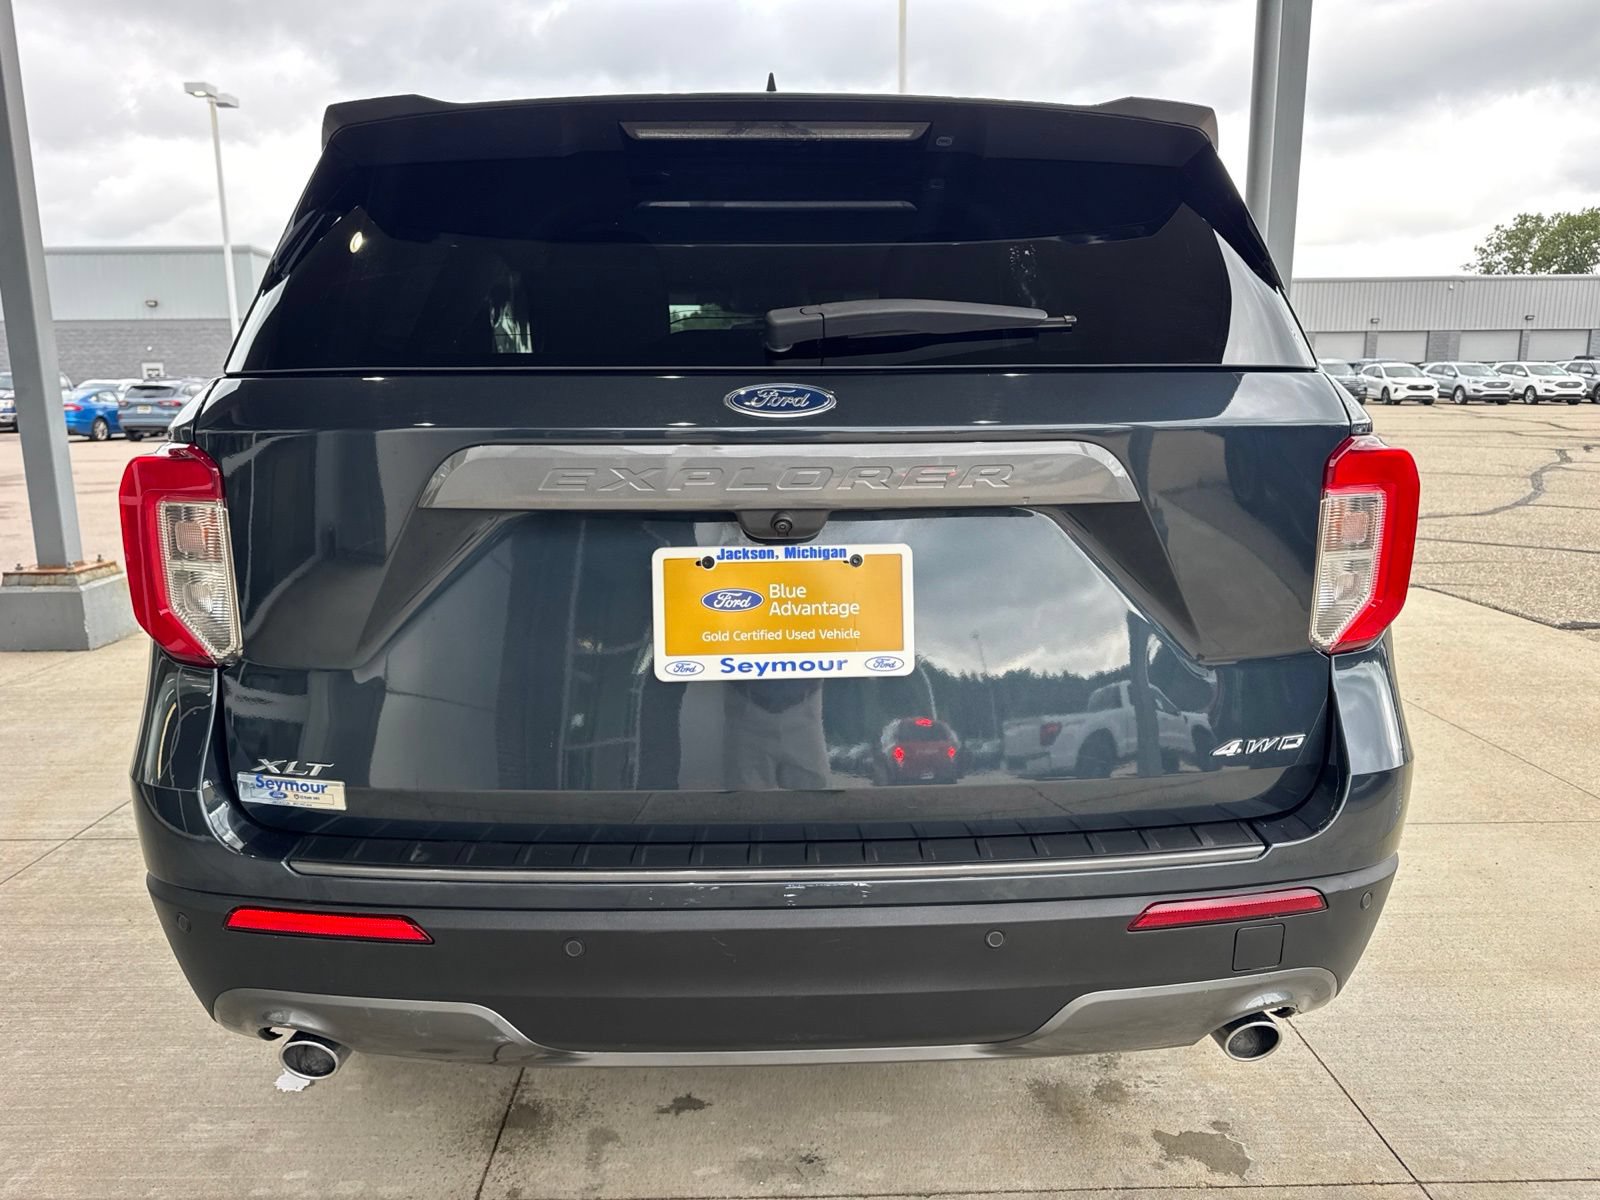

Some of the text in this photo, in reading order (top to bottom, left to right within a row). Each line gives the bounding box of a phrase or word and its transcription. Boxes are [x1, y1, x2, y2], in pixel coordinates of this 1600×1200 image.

[752, 389, 810, 409] Ford
[537, 462, 1018, 493] EXPLORER
[716, 546, 847, 561] Jackson, Michigan
[769, 584, 806, 599] Blue
[713, 592, 752, 609] Ford
[769, 601, 860, 618] Advantage
[701, 628, 861, 642] Gold Certified Used Vehicle
[673, 662, 697, 674] Ford
[720, 657, 848, 676] Seymour
[872, 657, 897, 670] Ford
[1210, 733, 1307, 757] 4WD
[250, 758, 335, 776] XLT
[256, 774, 327, 794] Seymour
